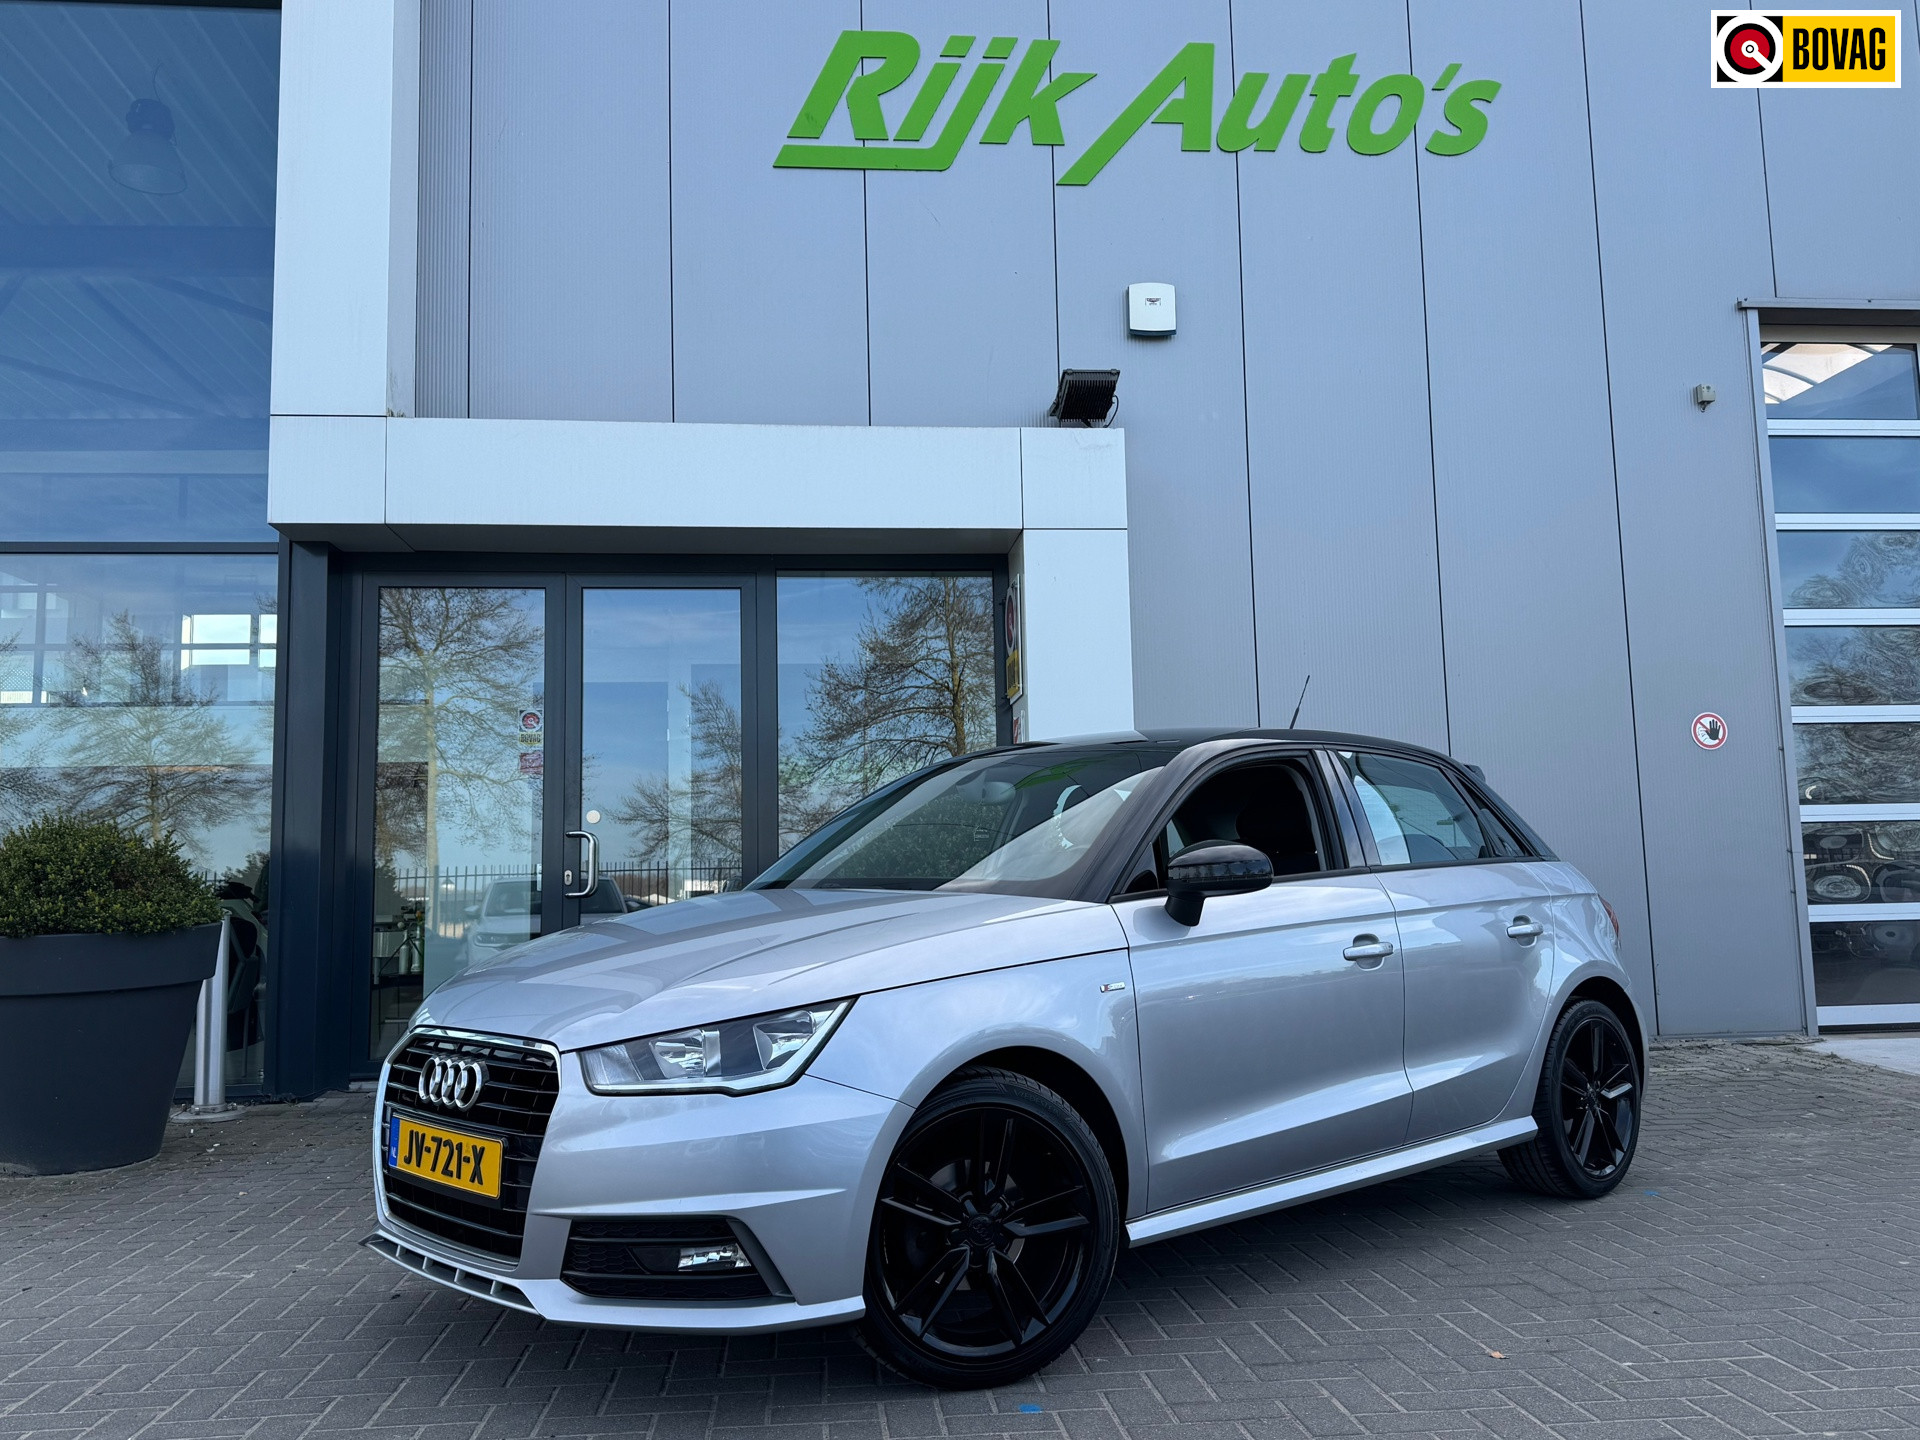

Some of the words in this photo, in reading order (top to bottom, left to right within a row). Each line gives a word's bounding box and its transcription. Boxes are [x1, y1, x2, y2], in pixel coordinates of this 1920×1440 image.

[773, 30, 1097, 171] Rijk
[1057, 42, 1501, 186] Auto's
[520, 733, 541, 743] BOVAG
[403, 1129, 485, 1186] JV-721-X
